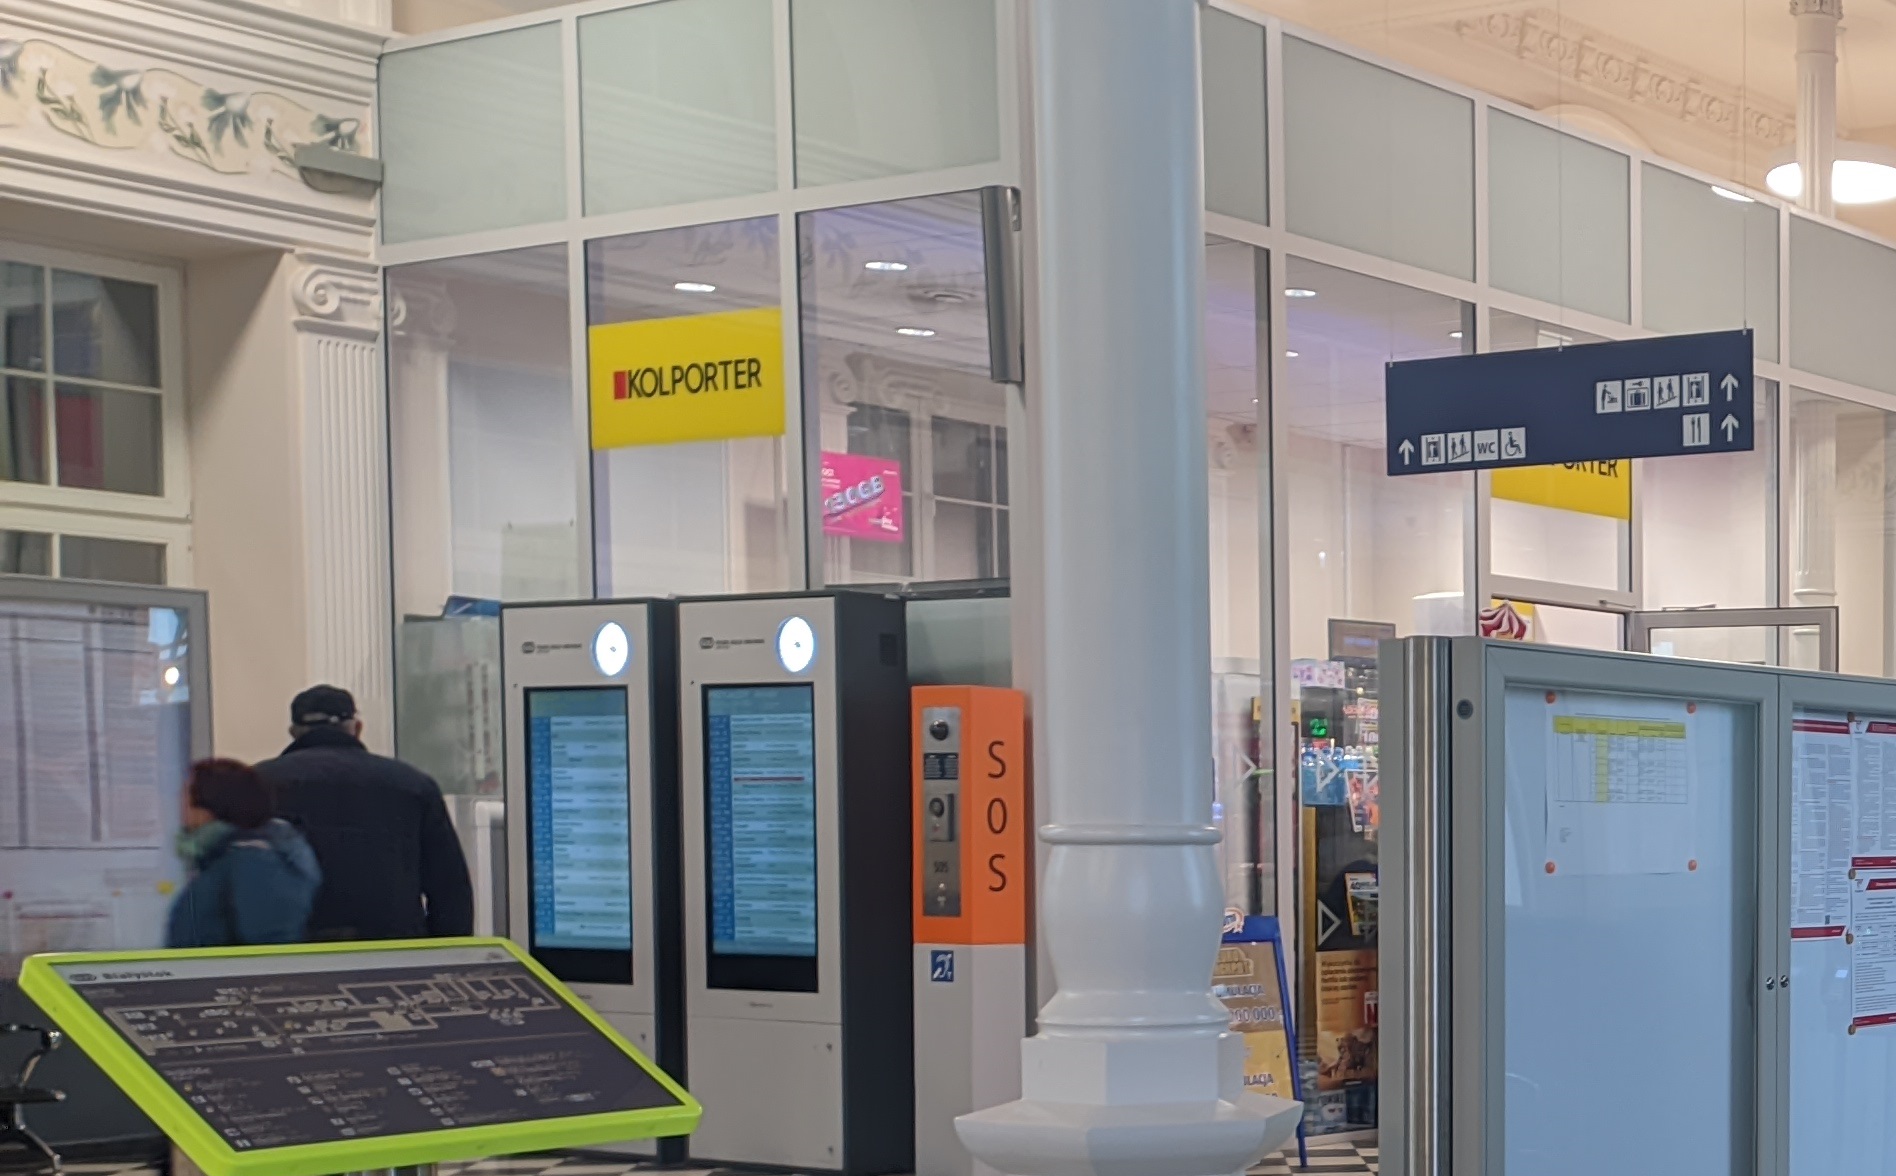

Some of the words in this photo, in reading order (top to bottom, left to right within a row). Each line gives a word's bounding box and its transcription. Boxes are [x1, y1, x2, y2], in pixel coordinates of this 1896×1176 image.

[627, 357, 763, 399] KOLPORTER
[1476, 441, 1496, 455] WC
[986, 740, 1008, 892] SOS
